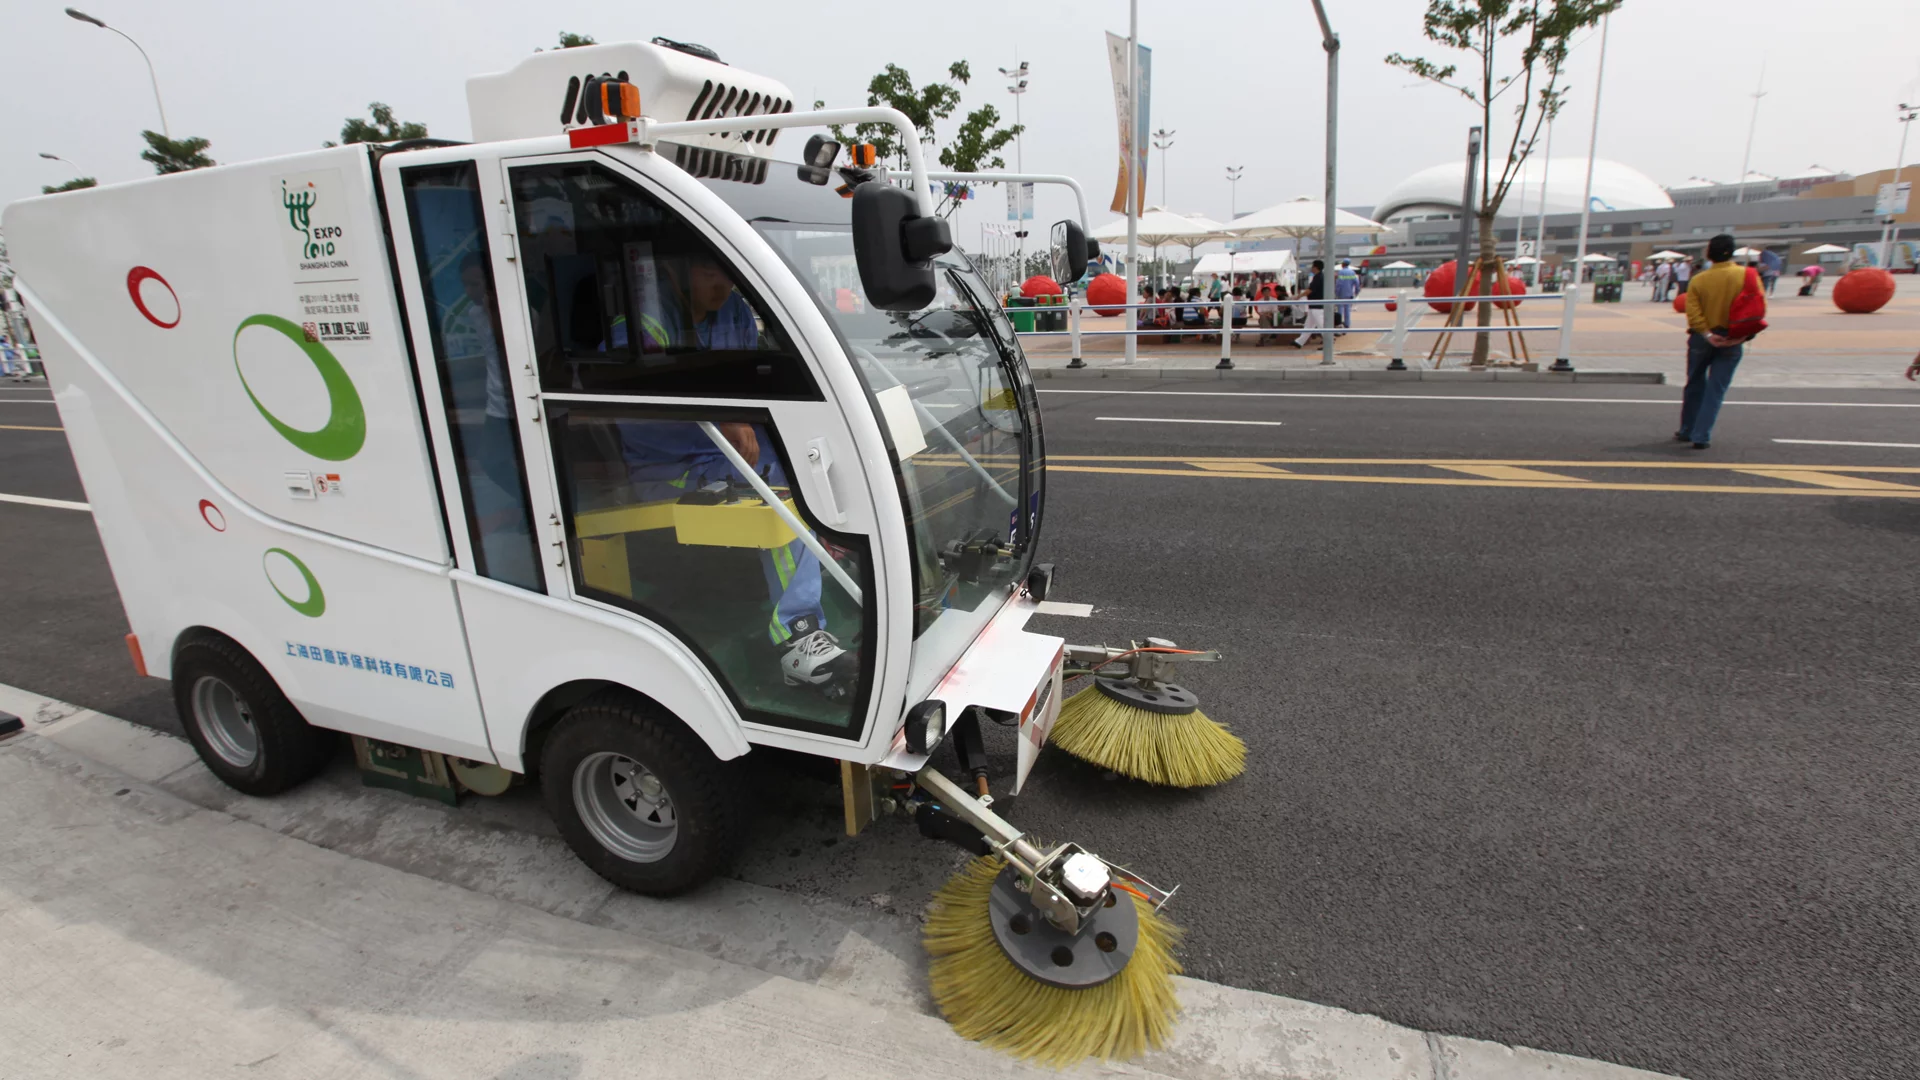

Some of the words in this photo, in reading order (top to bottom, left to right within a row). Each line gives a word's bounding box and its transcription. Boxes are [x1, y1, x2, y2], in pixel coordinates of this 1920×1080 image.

[313, 226, 342, 239] EXPO
[300, 261, 329, 270] SHANGHAI
[330, 260, 349, 268] CHINA
[319, 321, 370, 335] 环境实业
